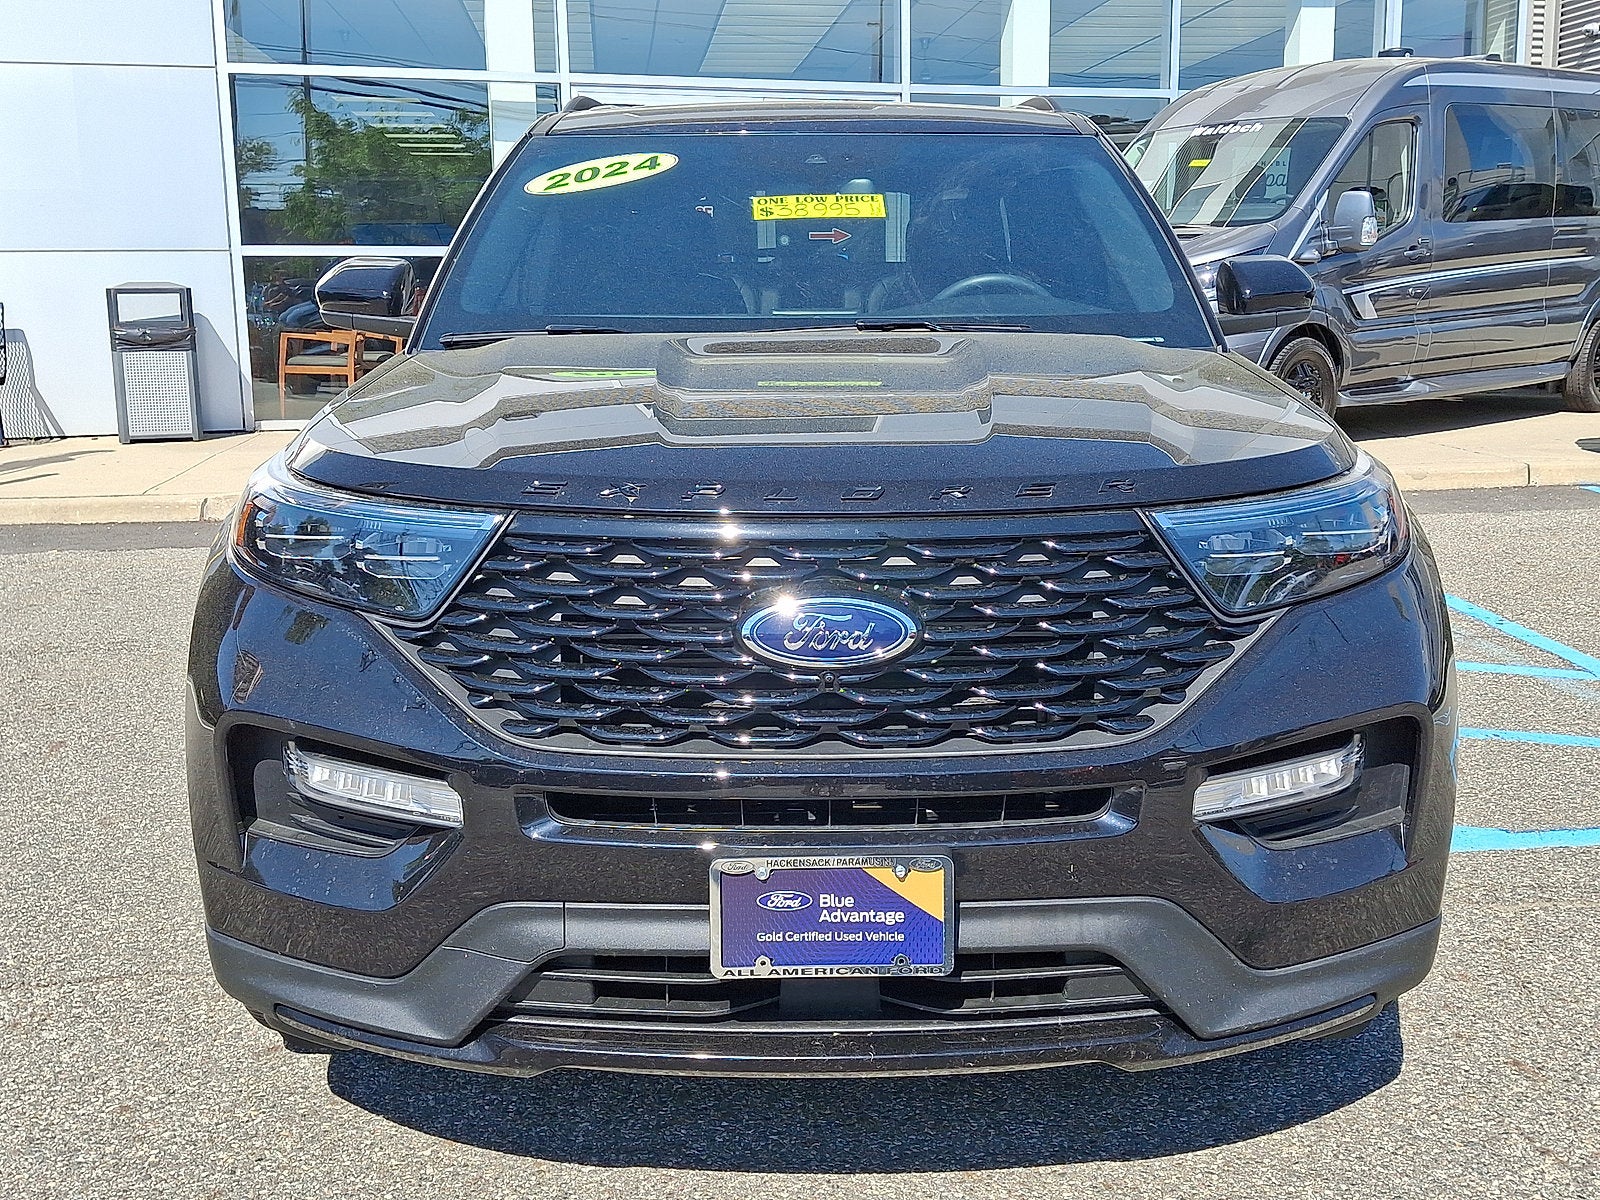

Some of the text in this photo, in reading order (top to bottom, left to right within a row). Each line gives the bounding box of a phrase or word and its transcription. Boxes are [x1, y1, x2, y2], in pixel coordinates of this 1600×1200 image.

[543, 155, 661, 191] 2024
[757, 195, 879, 205] ONE LOW PRICE
[521, 478, 1136, 503] EXPLORER
[783, 612, 876, 651] Ford
[767, 893, 802, 908] Ford
[819, 894, 855, 908] Blue
[819, 909, 905, 925] Advantage
[756, 931, 905, 942] Gold Certified Used Vehicle
[722, 966, 943, 977] ALL AMERICAN FORD
